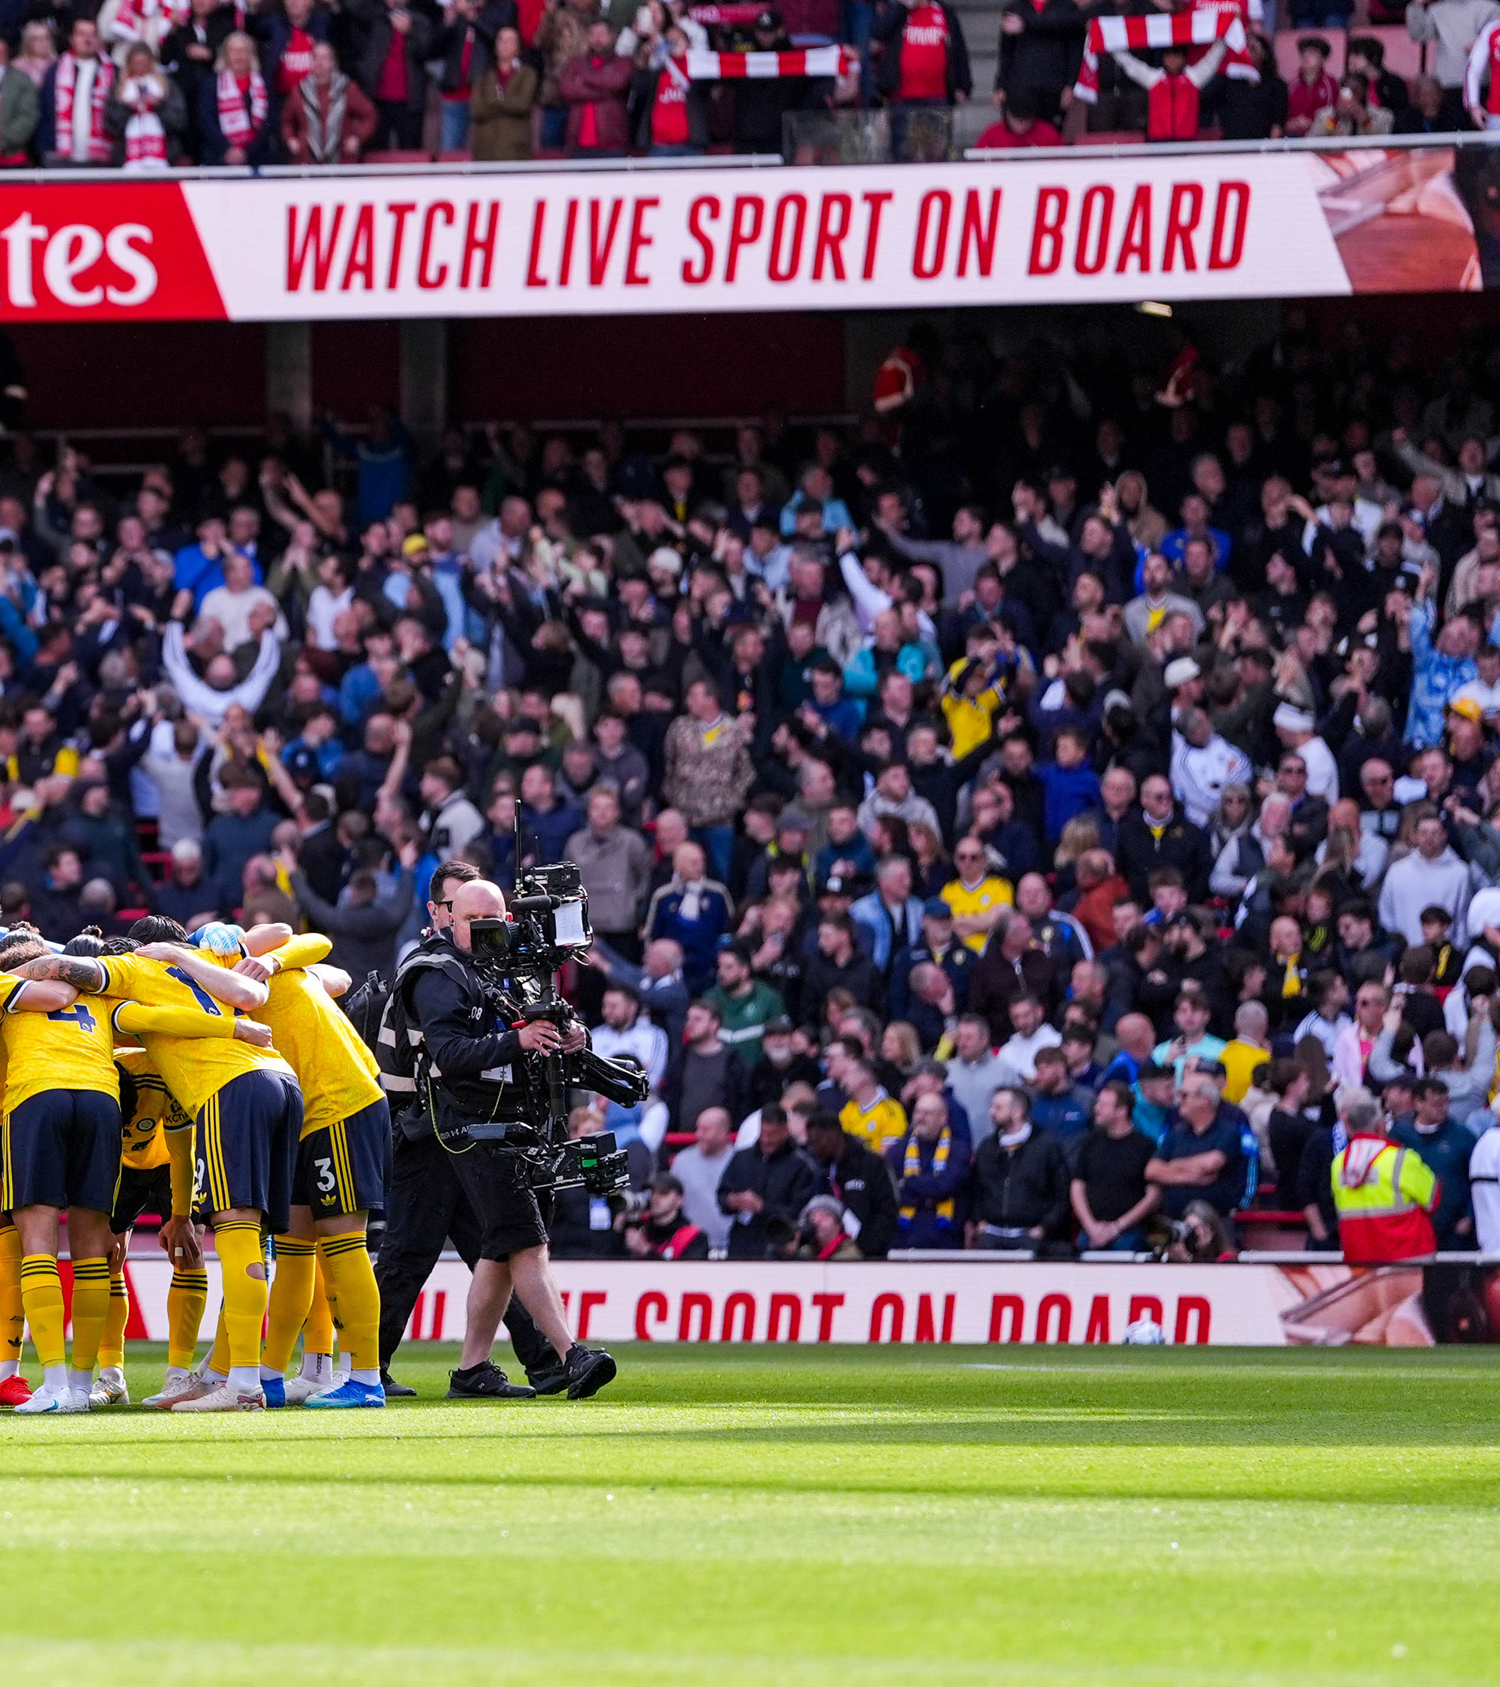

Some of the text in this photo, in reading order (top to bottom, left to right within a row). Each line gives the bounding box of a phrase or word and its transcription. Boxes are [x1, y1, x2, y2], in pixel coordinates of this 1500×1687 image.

[286, 180, 1252, 293] WATCH LIVE SPORT ON BOARD
[314, 1157, 336, 1192] 3
